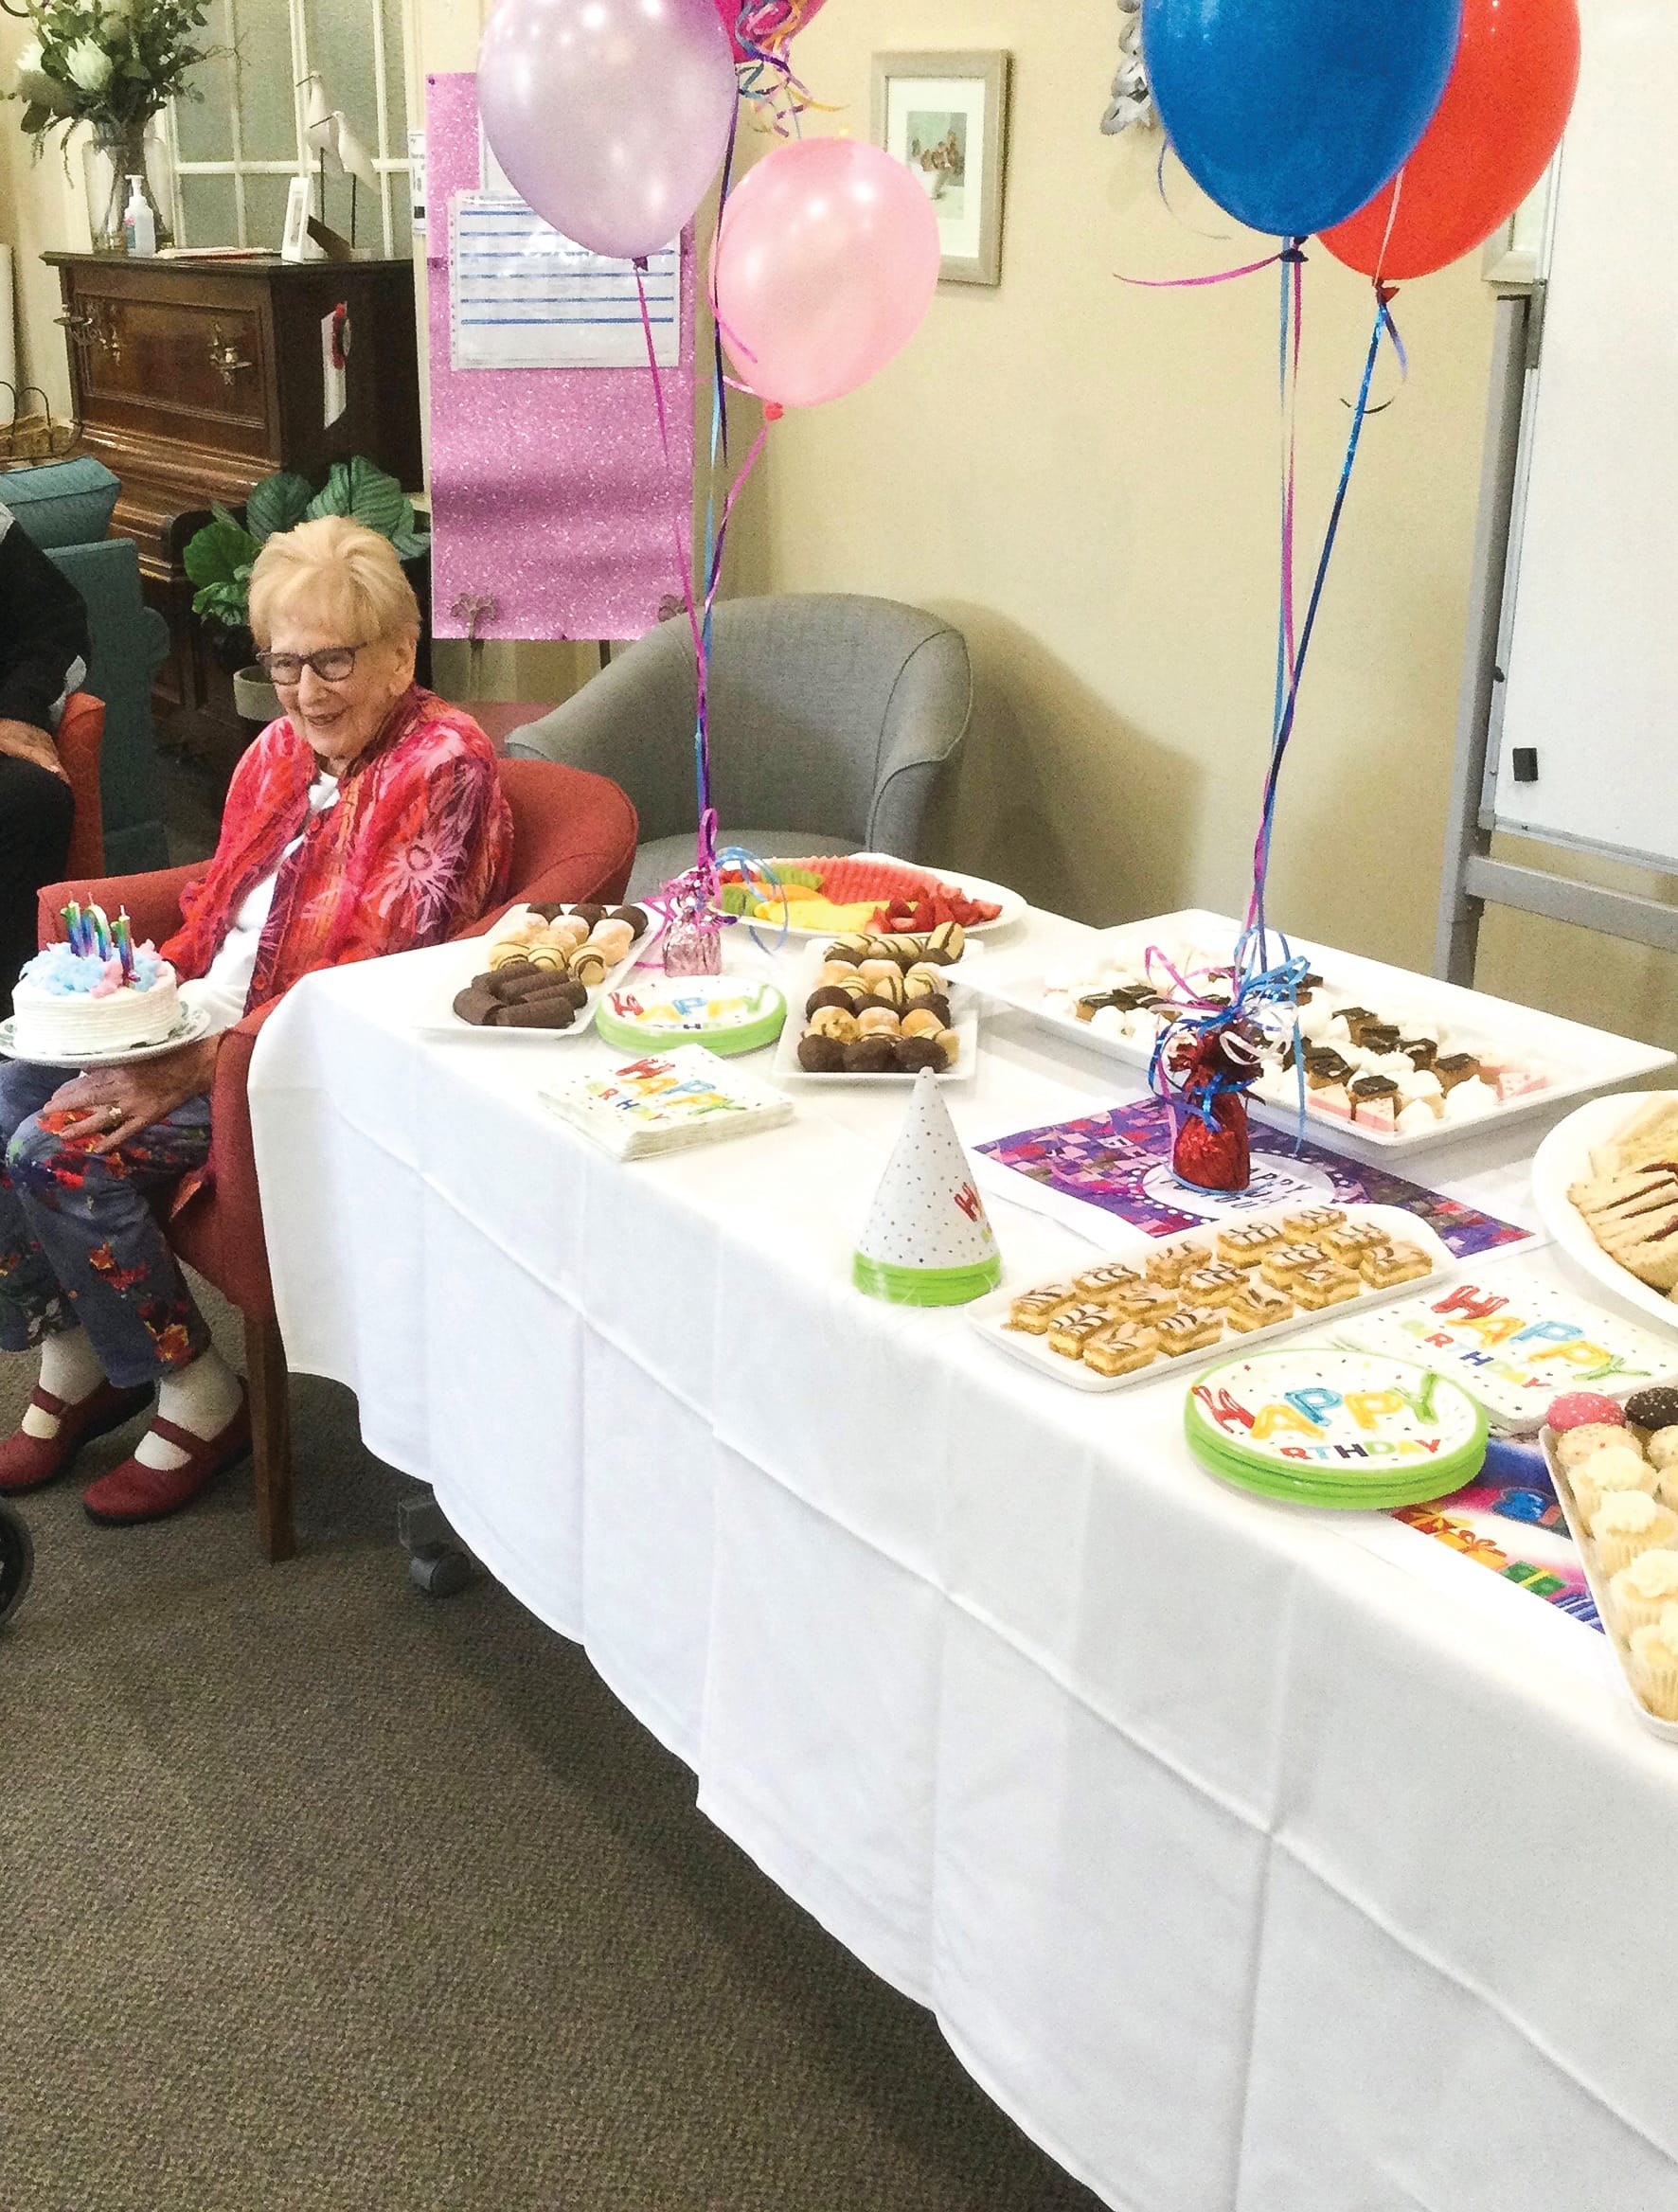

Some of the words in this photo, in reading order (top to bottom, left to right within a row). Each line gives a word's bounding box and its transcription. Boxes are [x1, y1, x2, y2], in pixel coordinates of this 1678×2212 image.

[615, 1058, 748, 1115] HAPPY
[1430, 1284, 1653, 1381] HAPPY
[1191, 1371, 1438, 1439] HAPPY
